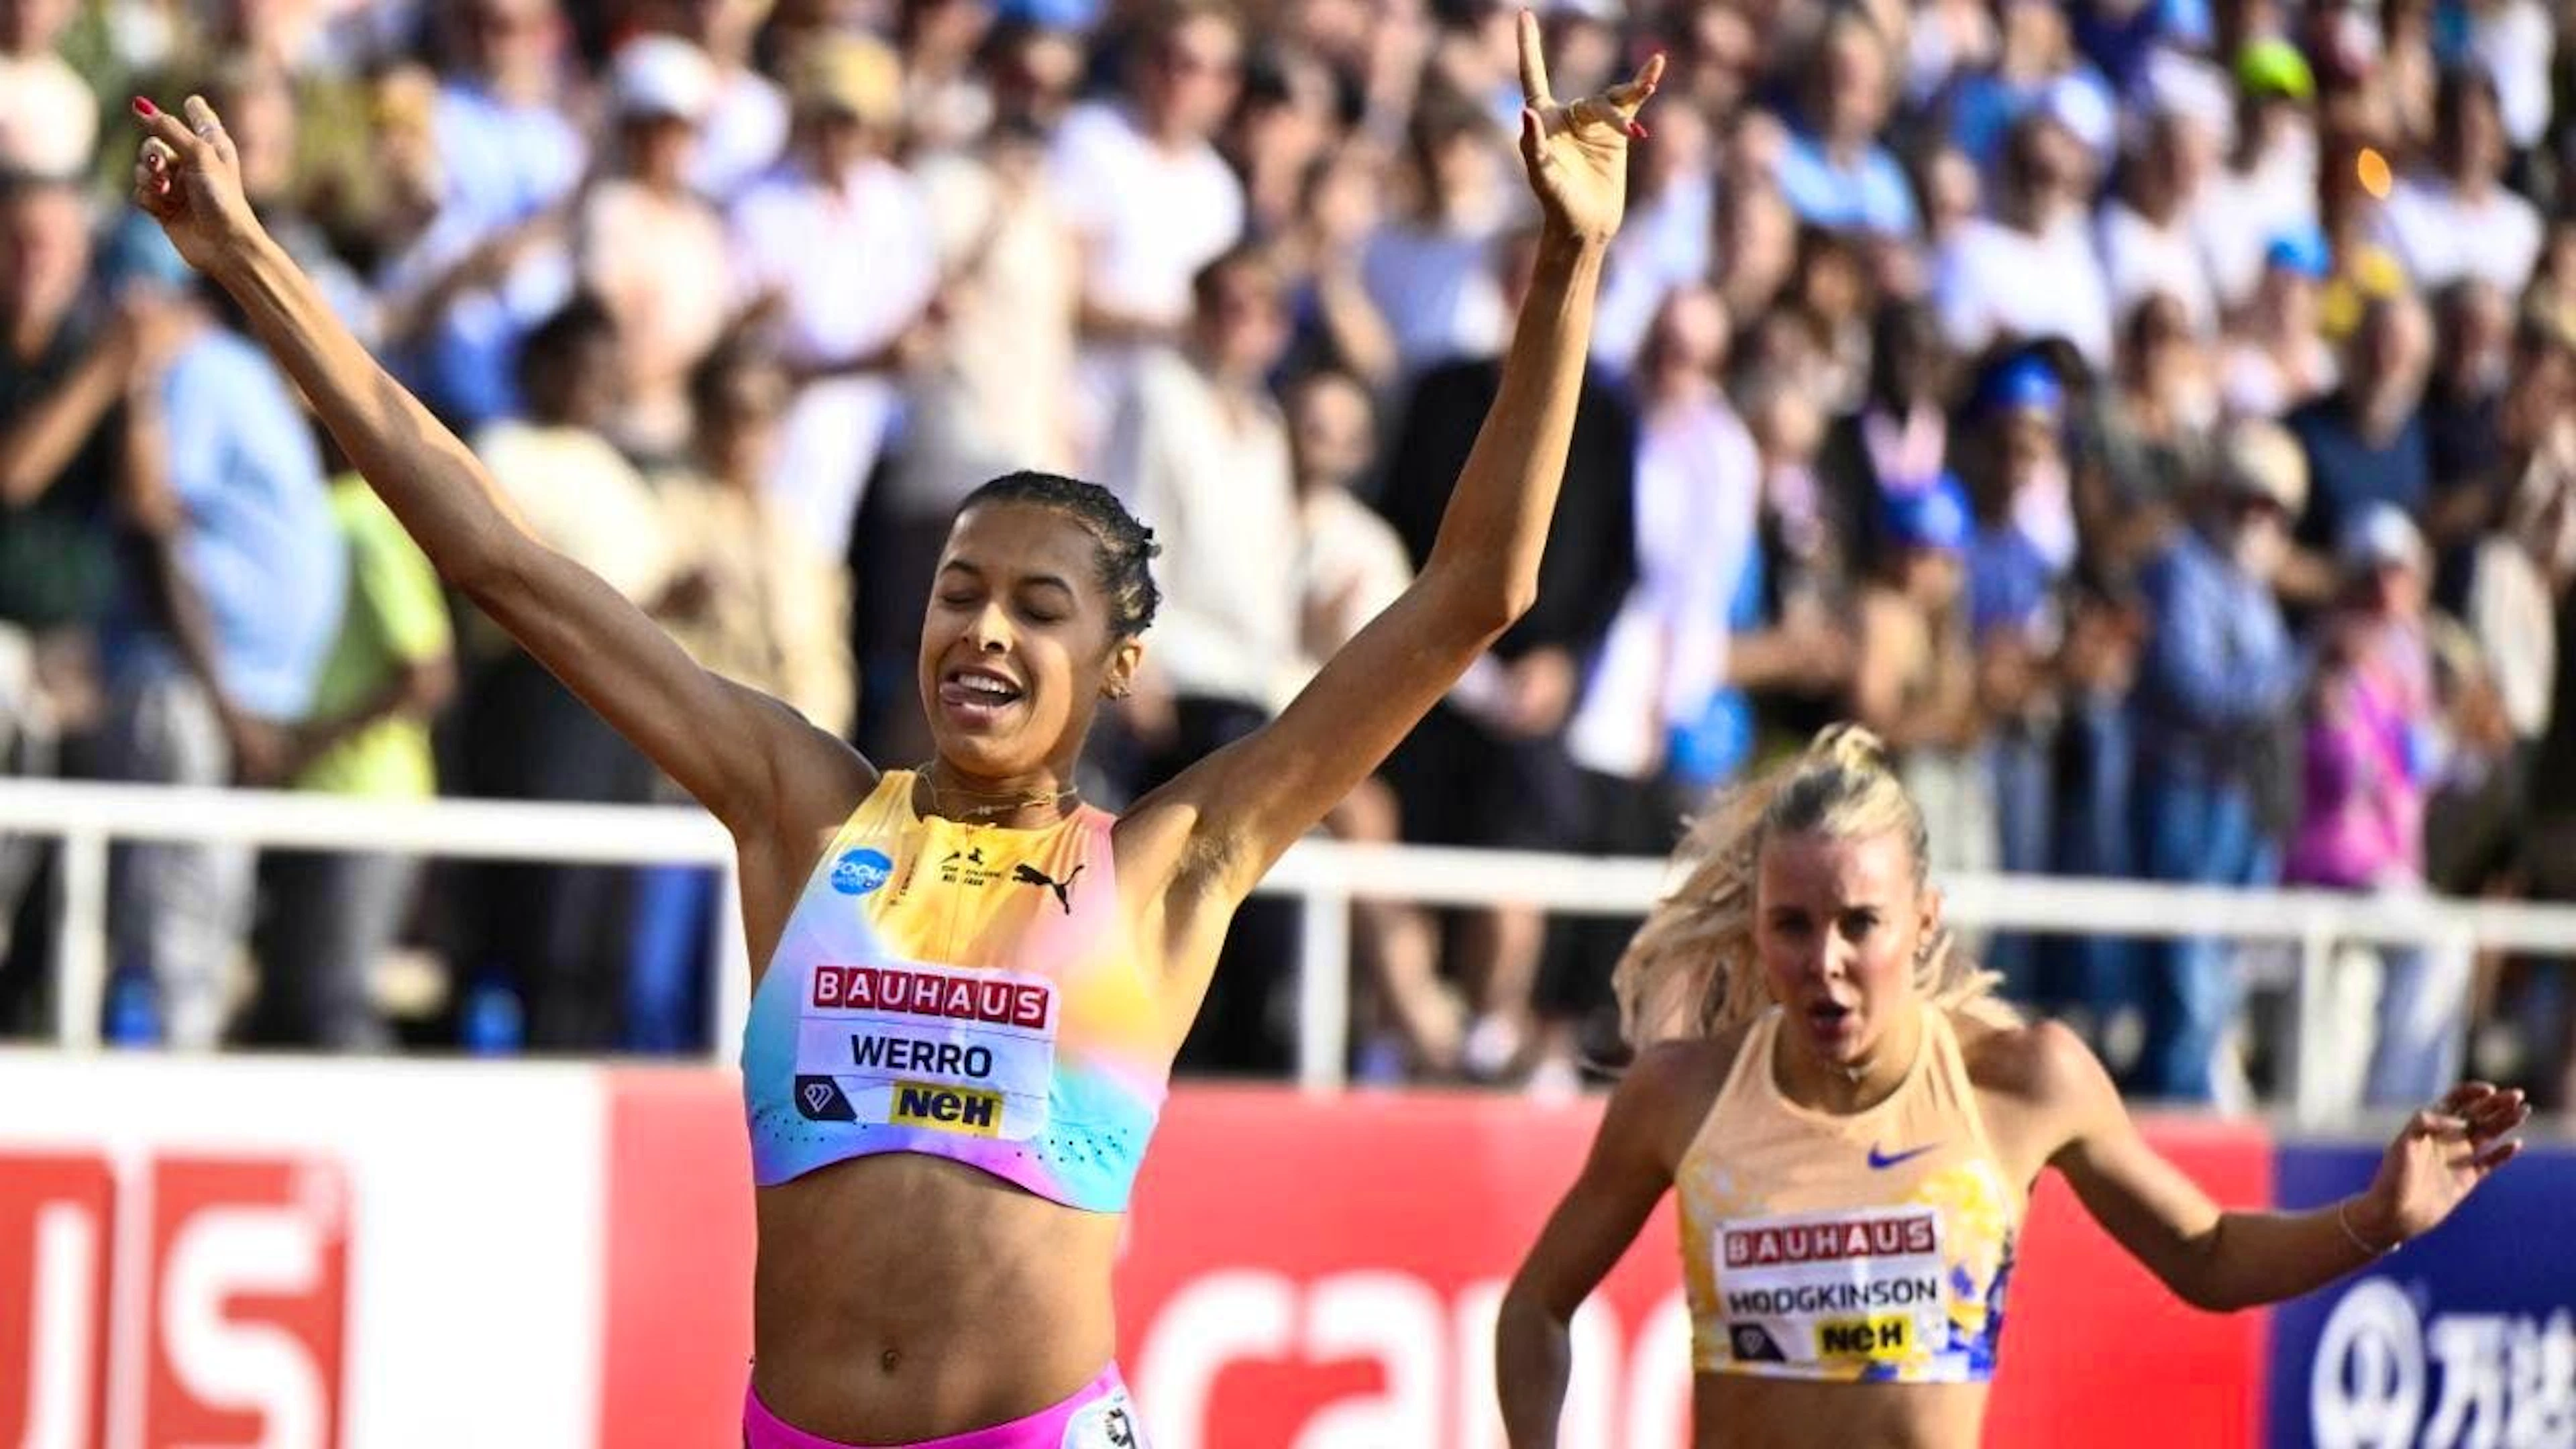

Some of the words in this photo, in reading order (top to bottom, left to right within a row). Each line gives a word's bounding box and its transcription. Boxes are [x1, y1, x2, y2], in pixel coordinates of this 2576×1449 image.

[817, 971, 1044, 1021] BAUHAUS
[851, 1034, 992, 1078] WERRO
[1727, 1220, 1931, 1264] BAUHAUS
[1729, 1278, 1937, 1313] HODGKINSON
